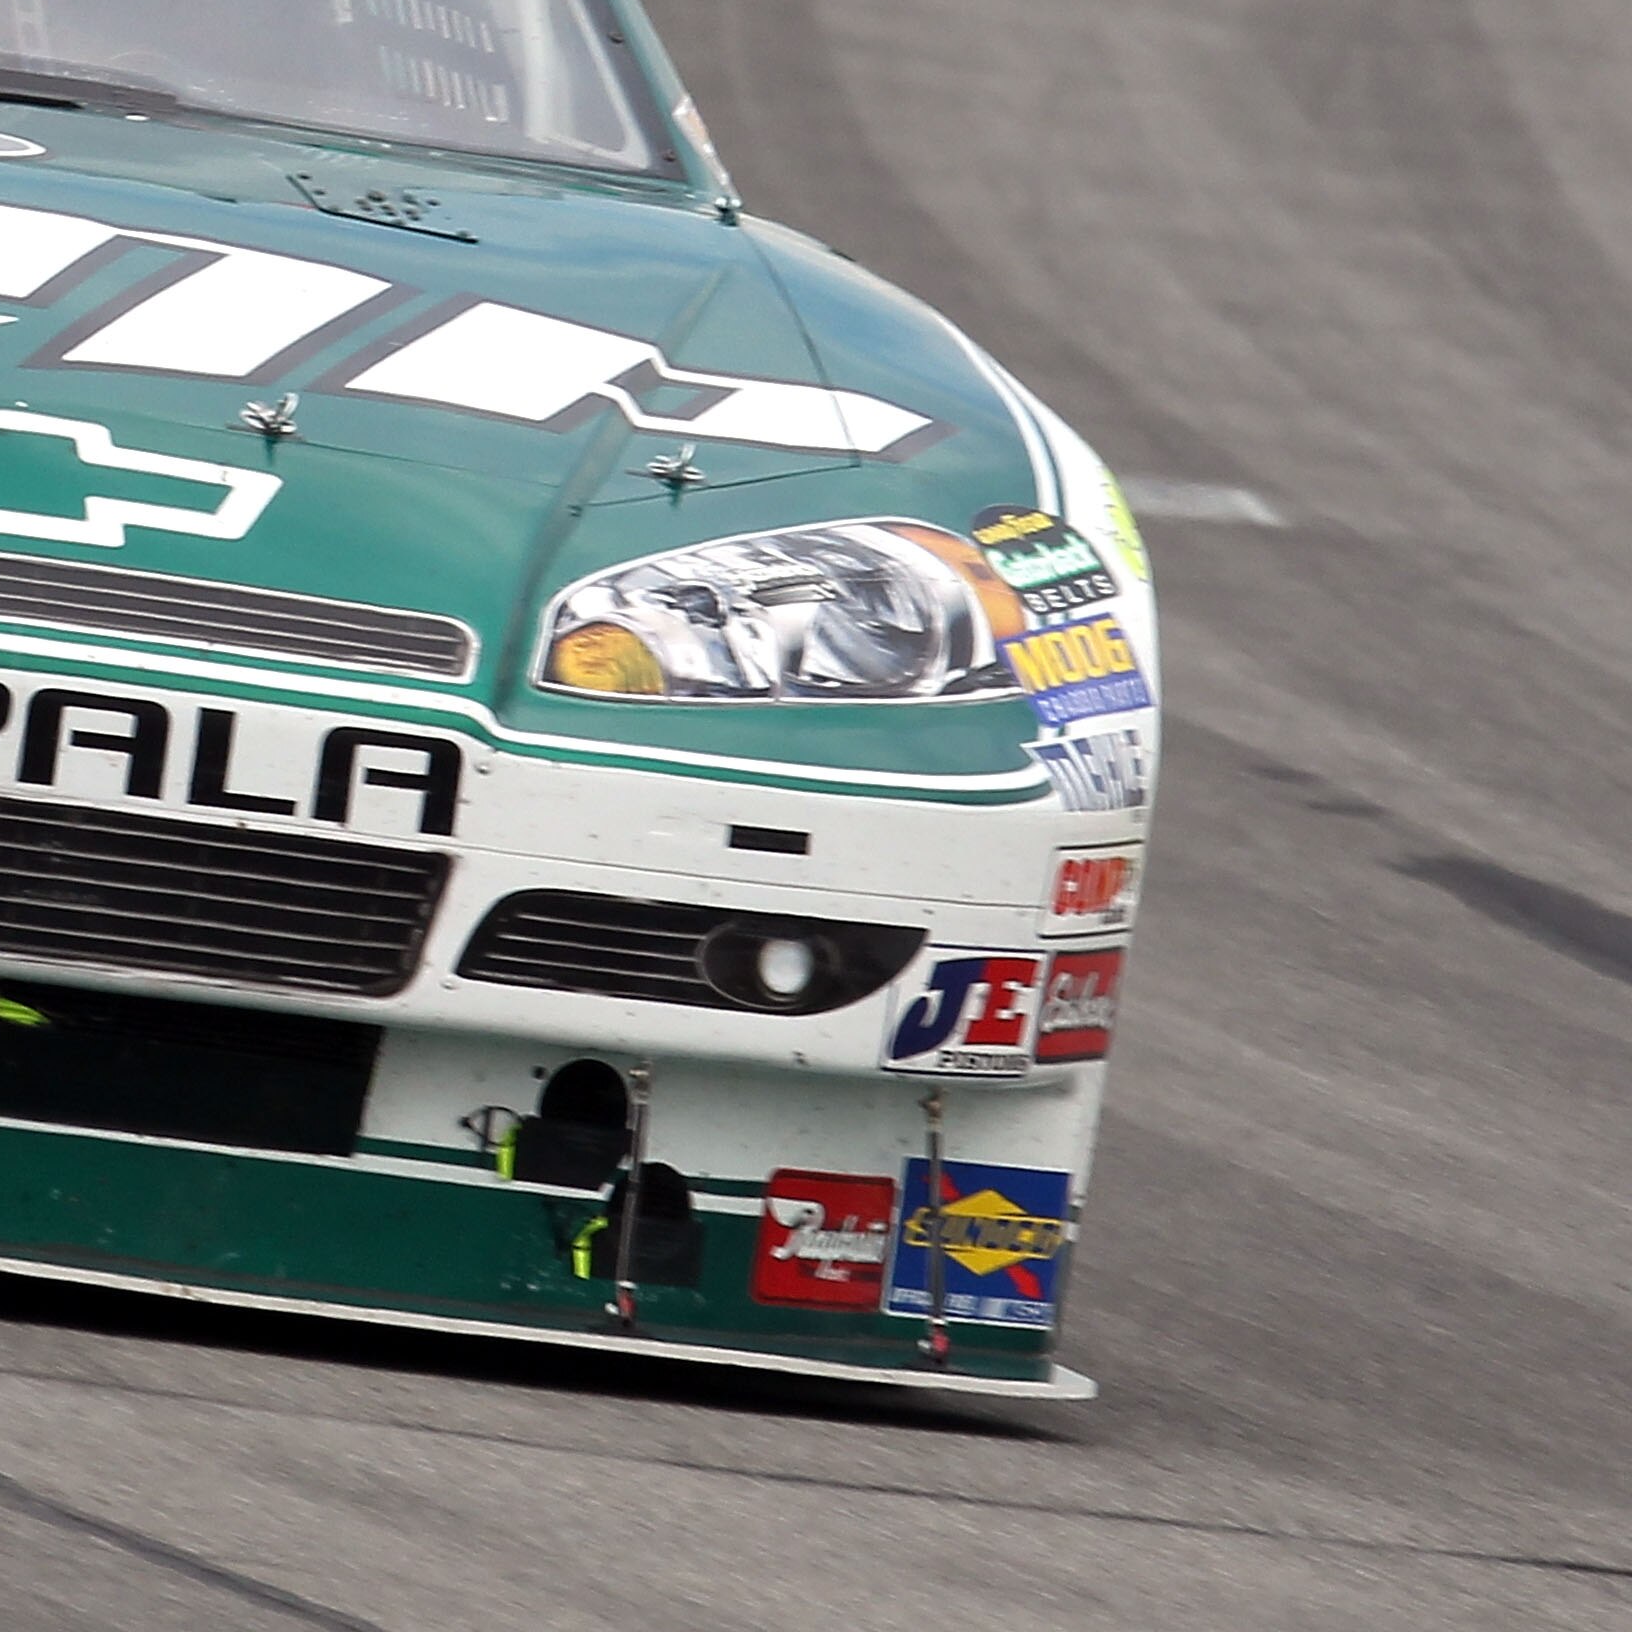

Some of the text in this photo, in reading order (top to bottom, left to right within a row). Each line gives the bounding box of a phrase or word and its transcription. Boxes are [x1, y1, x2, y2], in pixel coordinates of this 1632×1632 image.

[1023, 573, 1117, 614] BELTS
[1002, 617, 1137, 696] MOOG
[891, 956, 1039, 1061] JE
